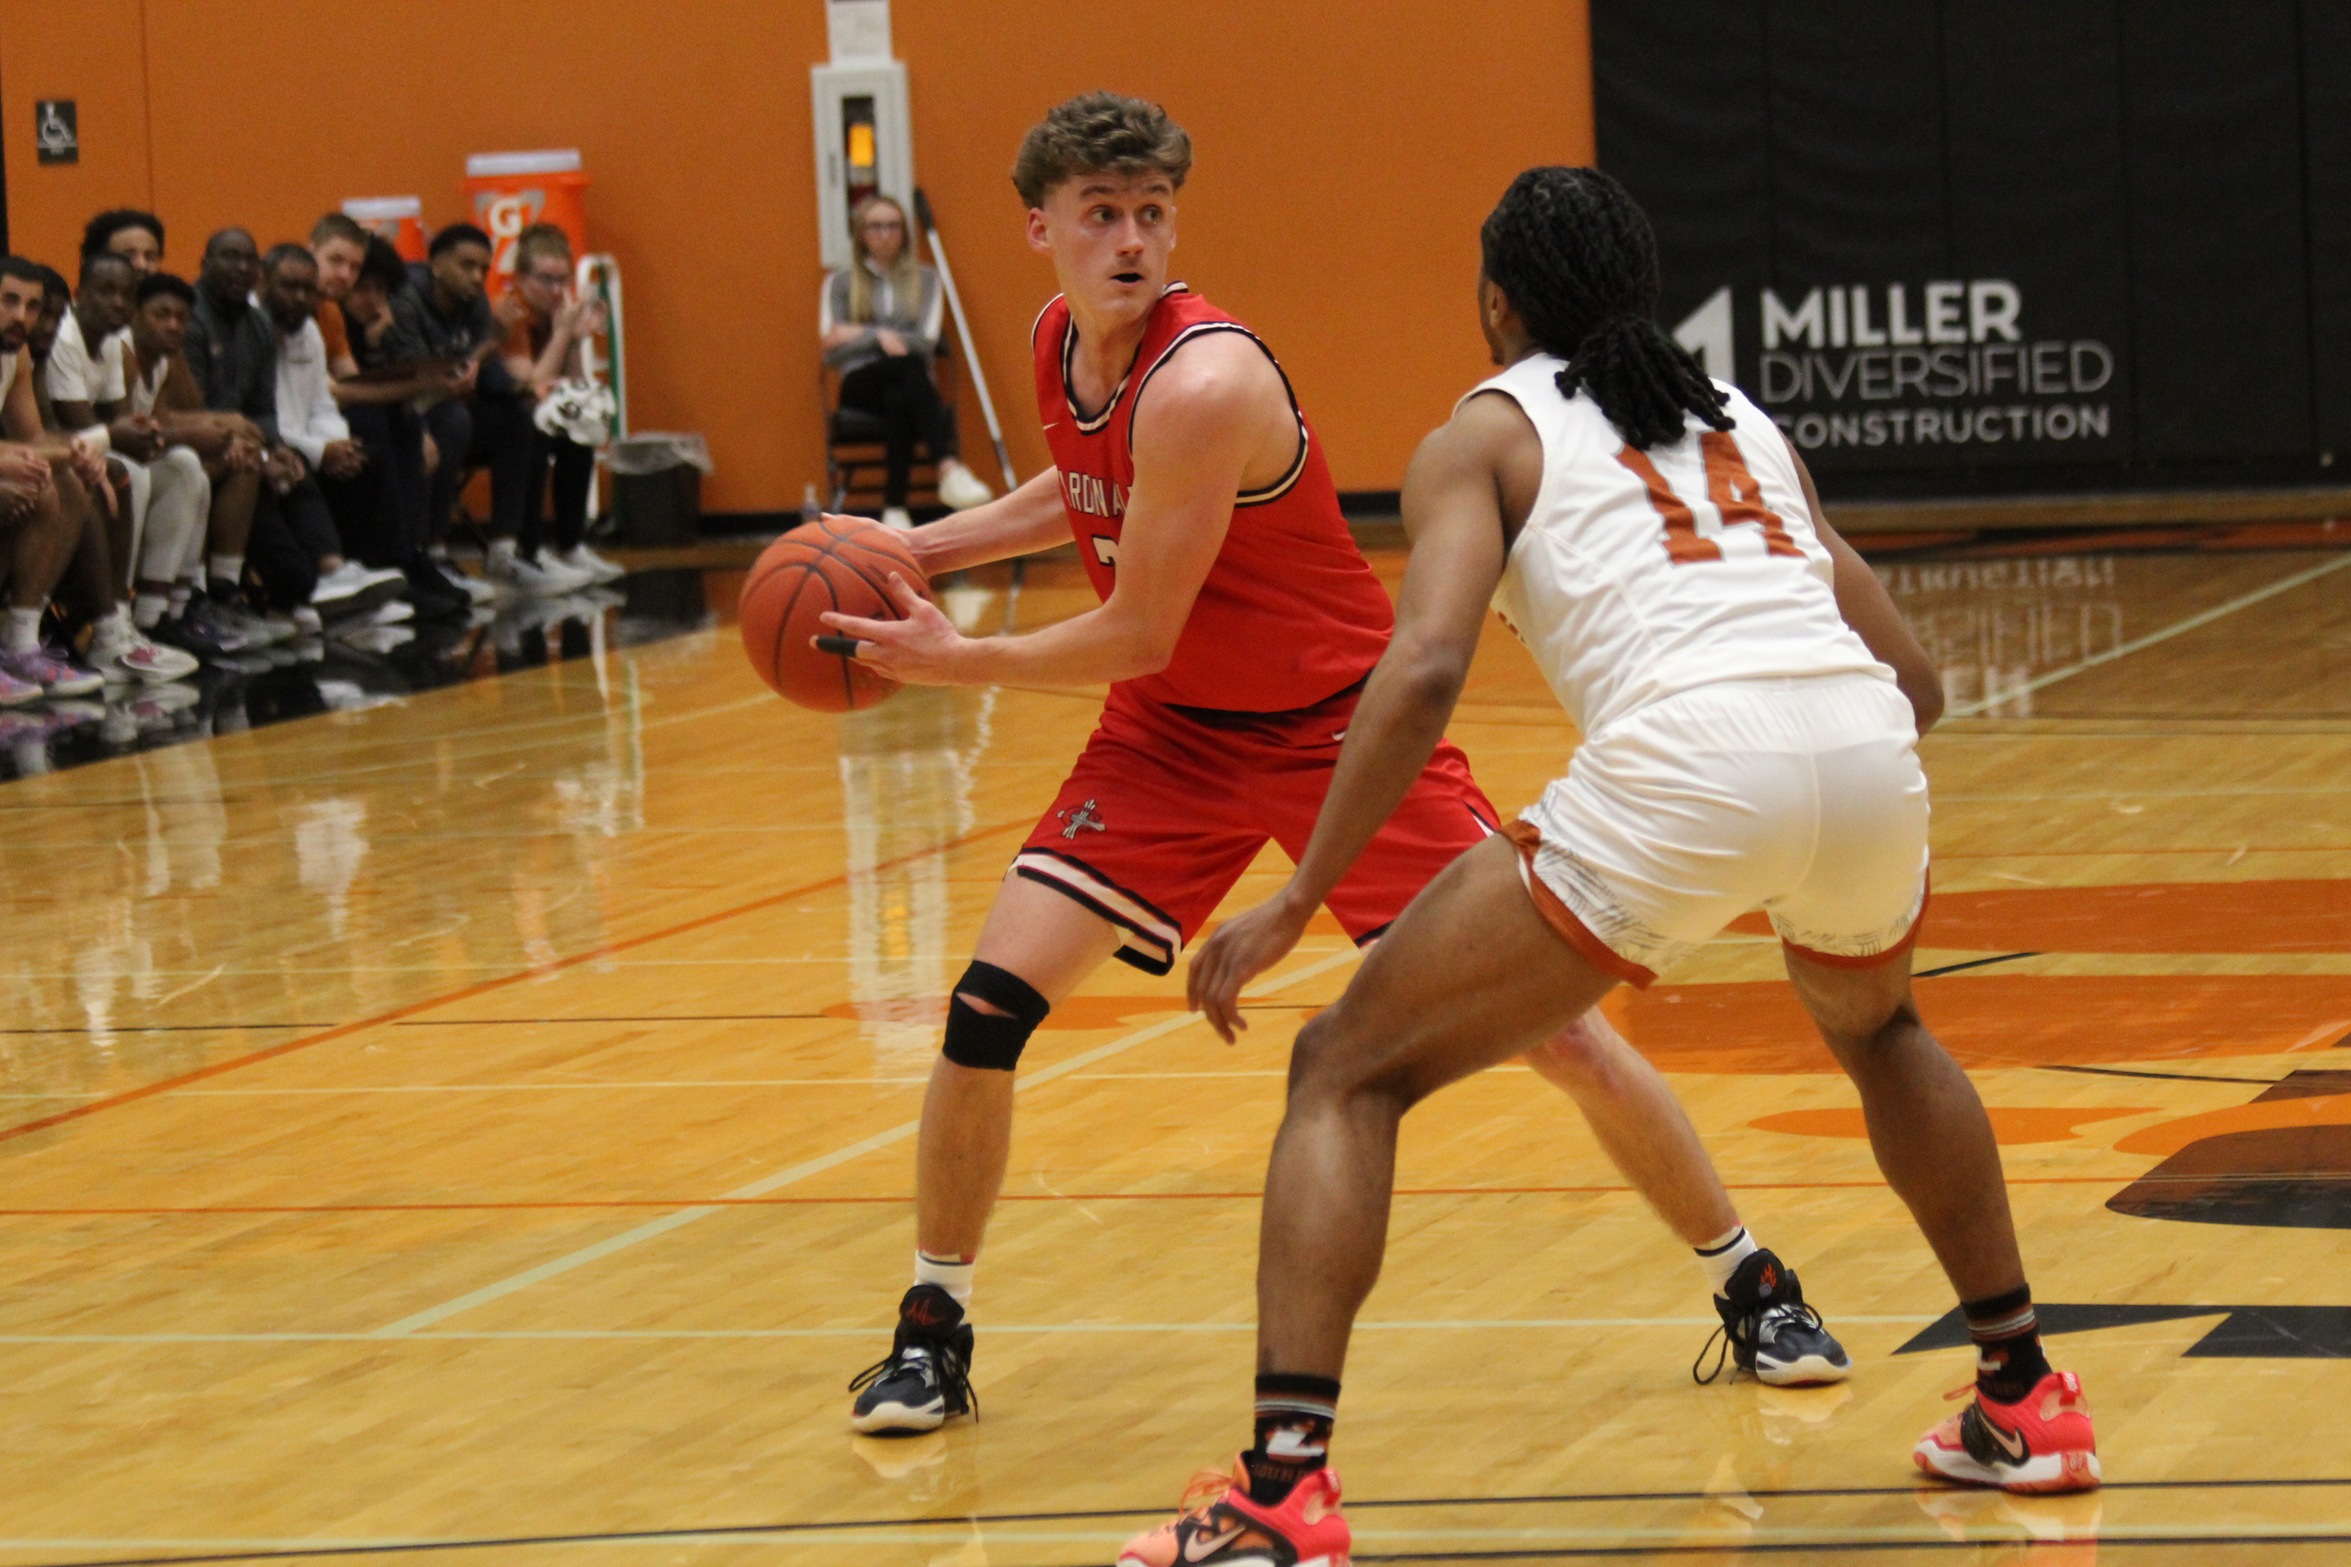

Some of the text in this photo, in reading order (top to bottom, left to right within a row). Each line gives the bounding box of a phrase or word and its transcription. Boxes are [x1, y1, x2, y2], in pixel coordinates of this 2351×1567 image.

[489, 196, 523, 237] G
[1761, 279, 2022, 349] MILLER
[1759, 339, 2114, 403] DIVERSIFIED
[1612, 430, 1808, 566] 14
